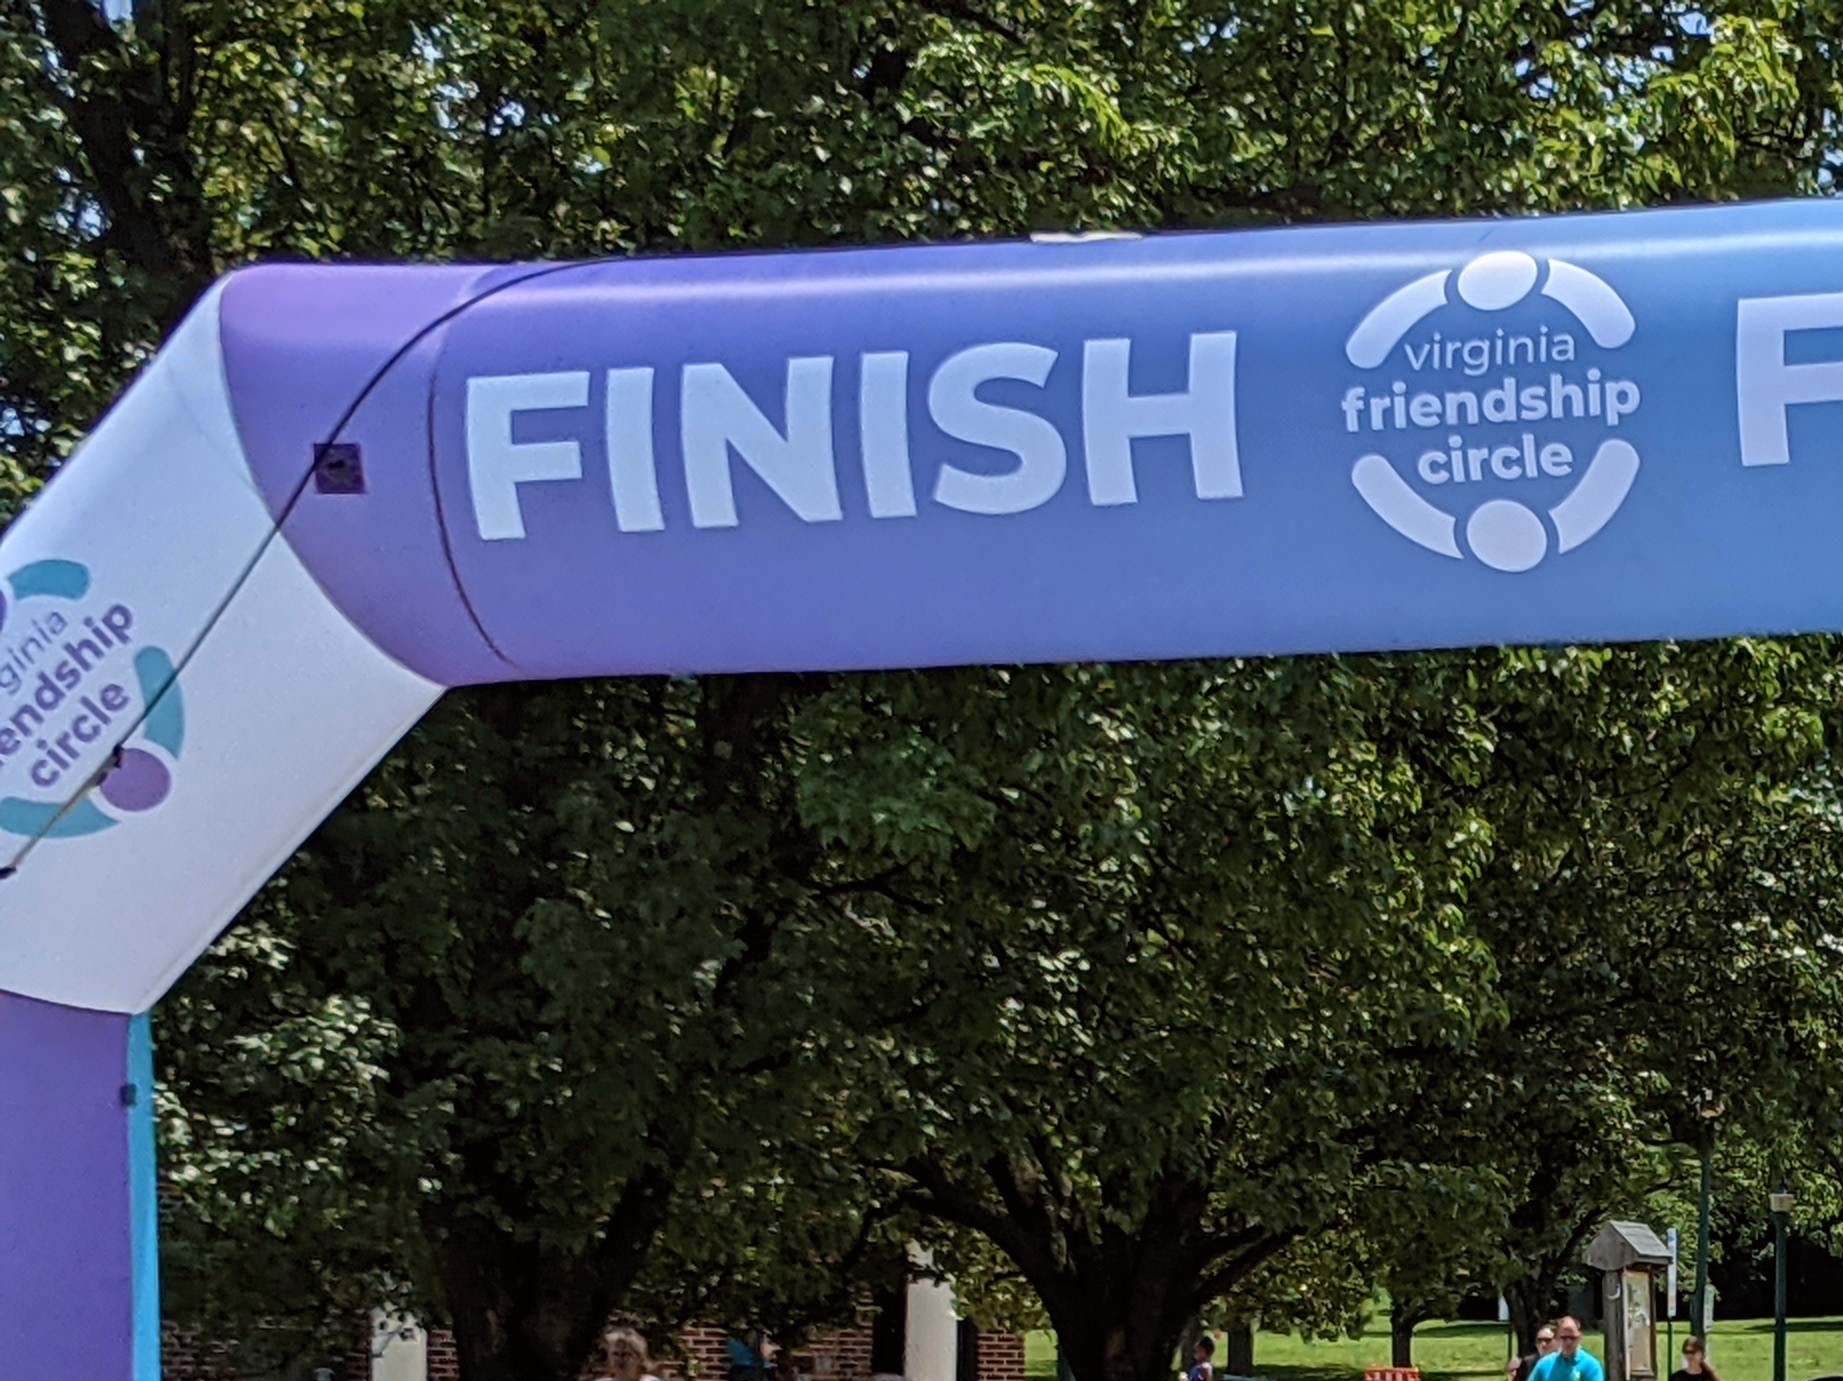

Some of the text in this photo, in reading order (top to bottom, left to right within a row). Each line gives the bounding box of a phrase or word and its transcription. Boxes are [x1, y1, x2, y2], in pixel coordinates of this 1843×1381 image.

[1403, 325, 1577, 377] virginia
[466, 330, 1243, 540] FINISH
[1341, 367, 1642, 433] friendship
[1417, 433, 1574, 485] circle
[0, 610, 69, 696] ginia
[0, 603, 134, 765] endship
[30, 682, 131, 788] circle
